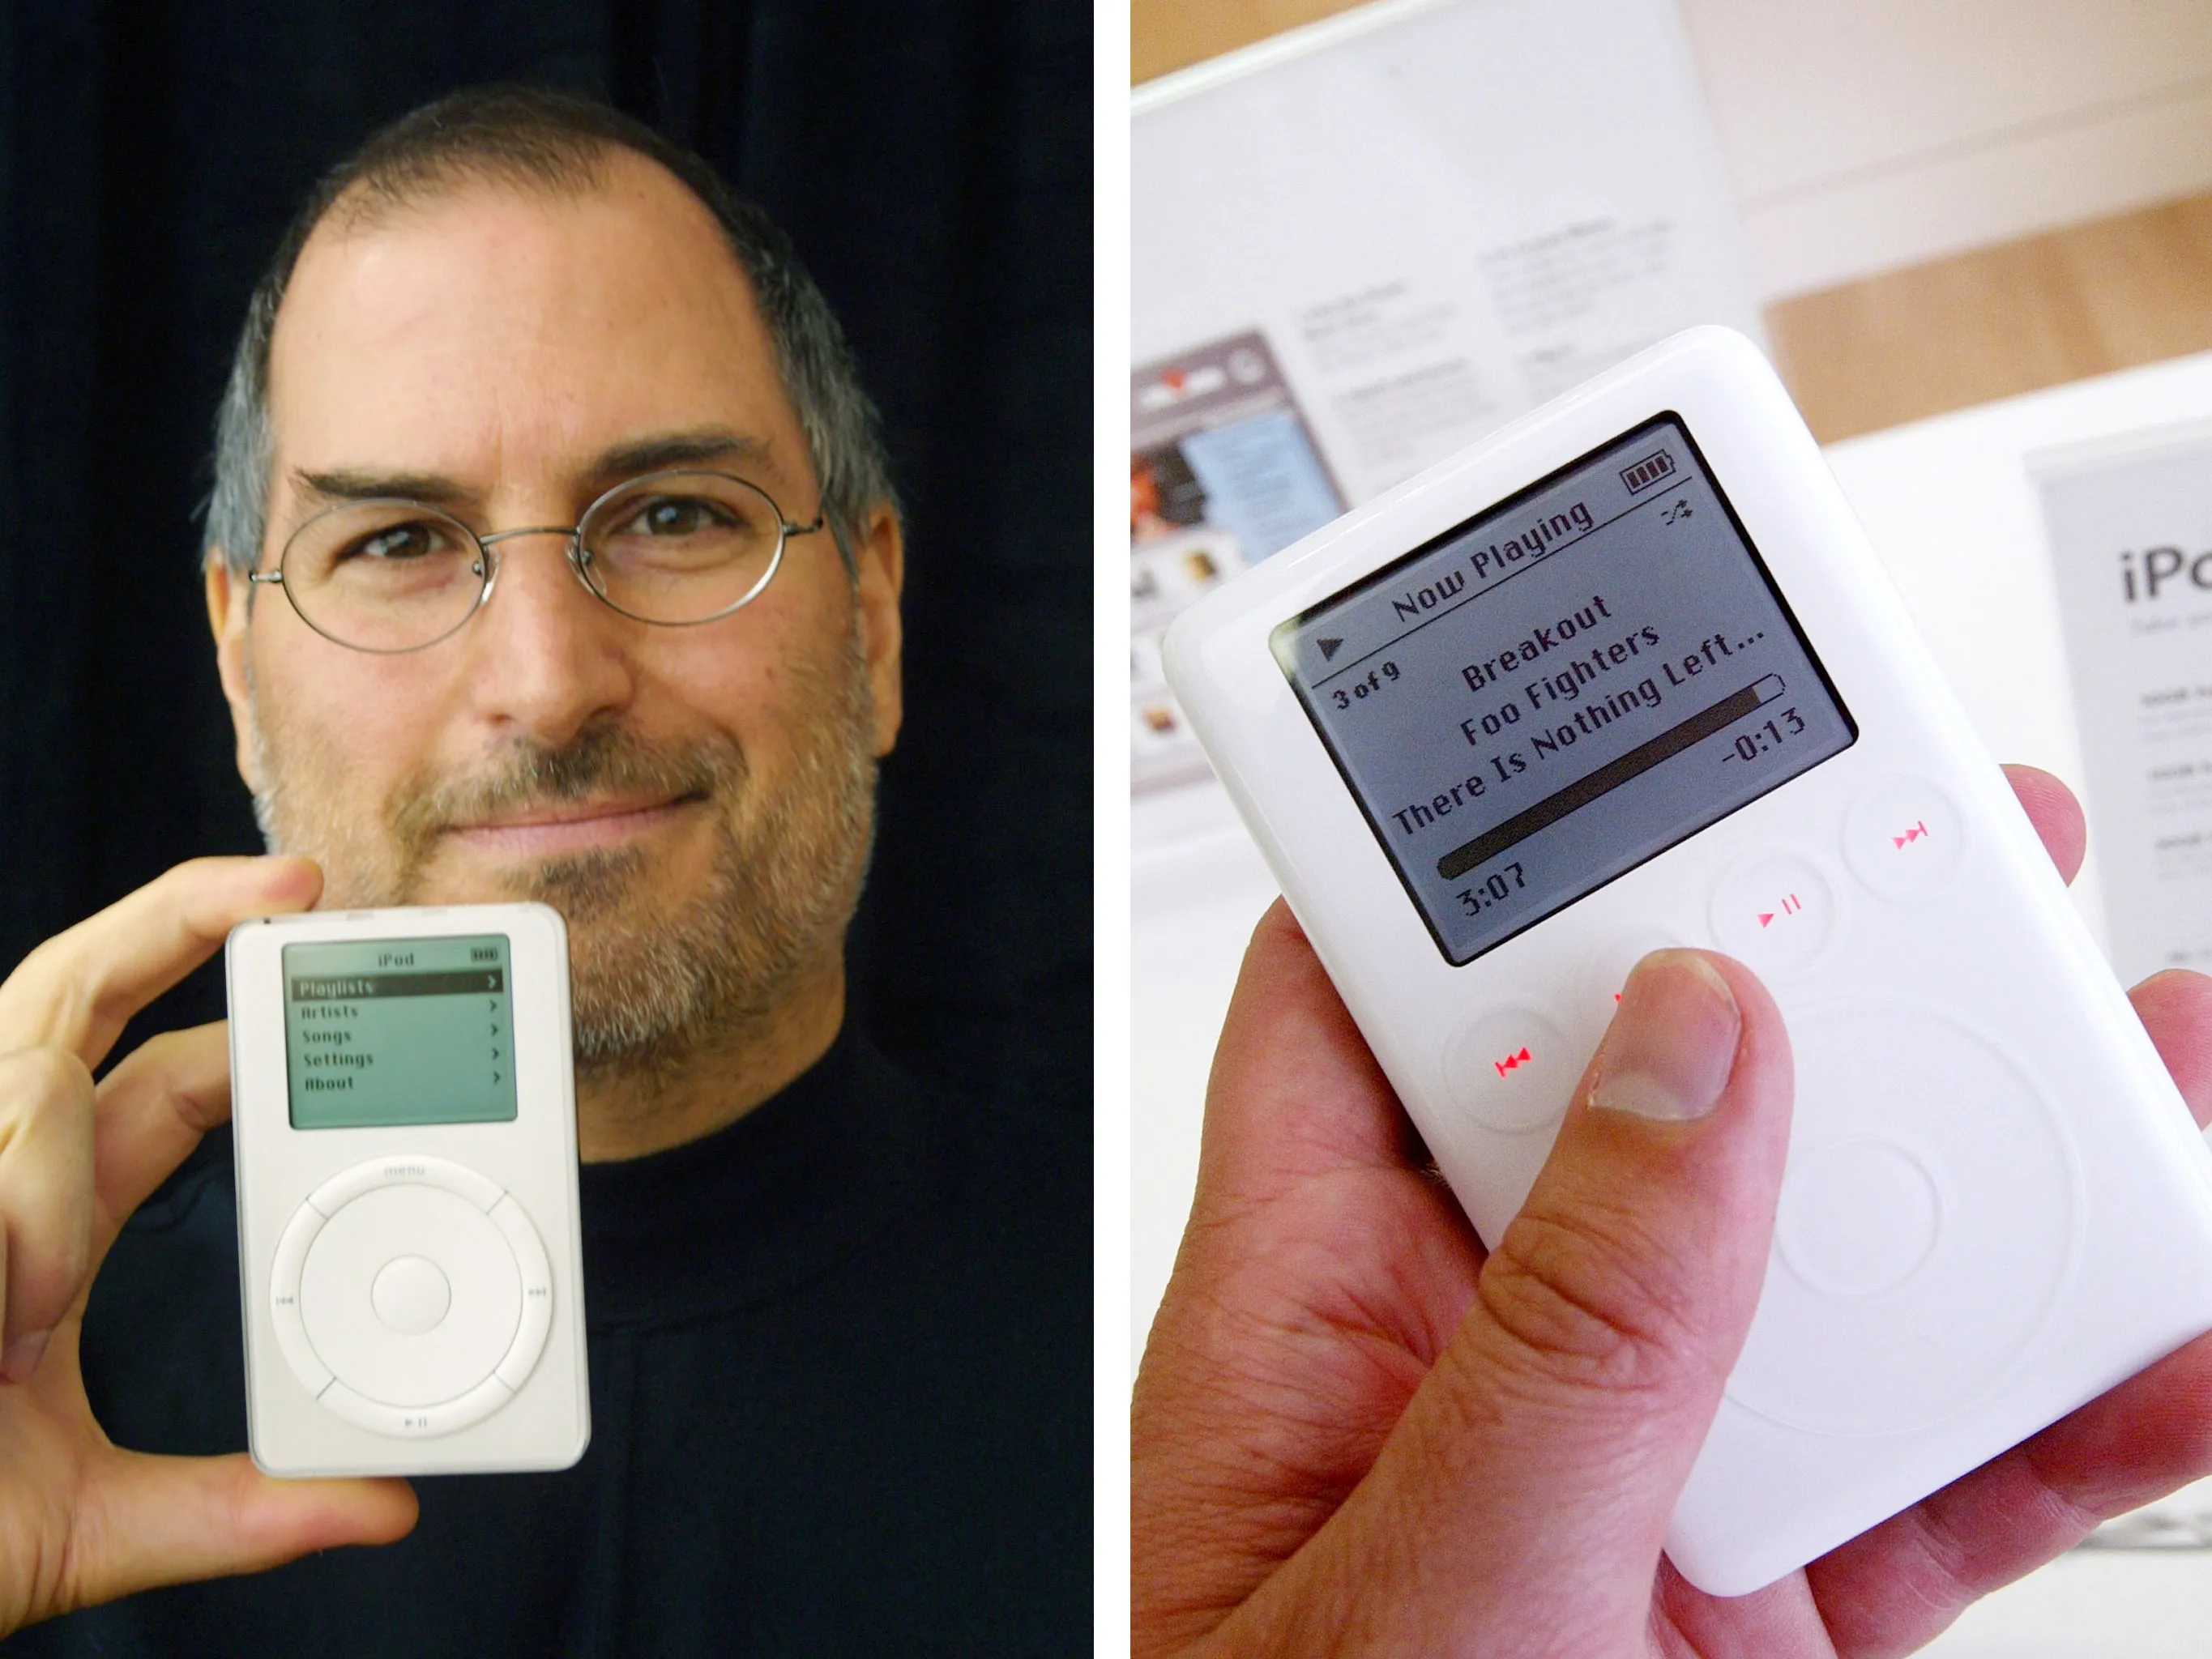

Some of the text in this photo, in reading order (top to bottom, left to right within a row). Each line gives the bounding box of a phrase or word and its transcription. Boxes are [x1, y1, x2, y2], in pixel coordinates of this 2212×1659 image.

[1393, 501, 1595, 622] Now Playing
[1462, 594, 1612, 692] Breakout
[1333, 662, 1402, 710] 3 of 9
[1461, 623, 1660, 745] Foo Fighters
[1393, 632, 1765, 835] There Is Nothing Left...
[1721, 707, 1808, 765] -0:13
[1456, 863, 1527, 917] 3:07
[378, 953, 414, 966] iPod
[300, 979, 374, 998] Playlists
[301, 1004, 358, 1019] Artists
[302, 1030, 352, 1045] Songs
[304, 1052, 374, 1068] Settings
[305, 1076, 353, 1090] About
[383, 1166, 425, 1175] menu
